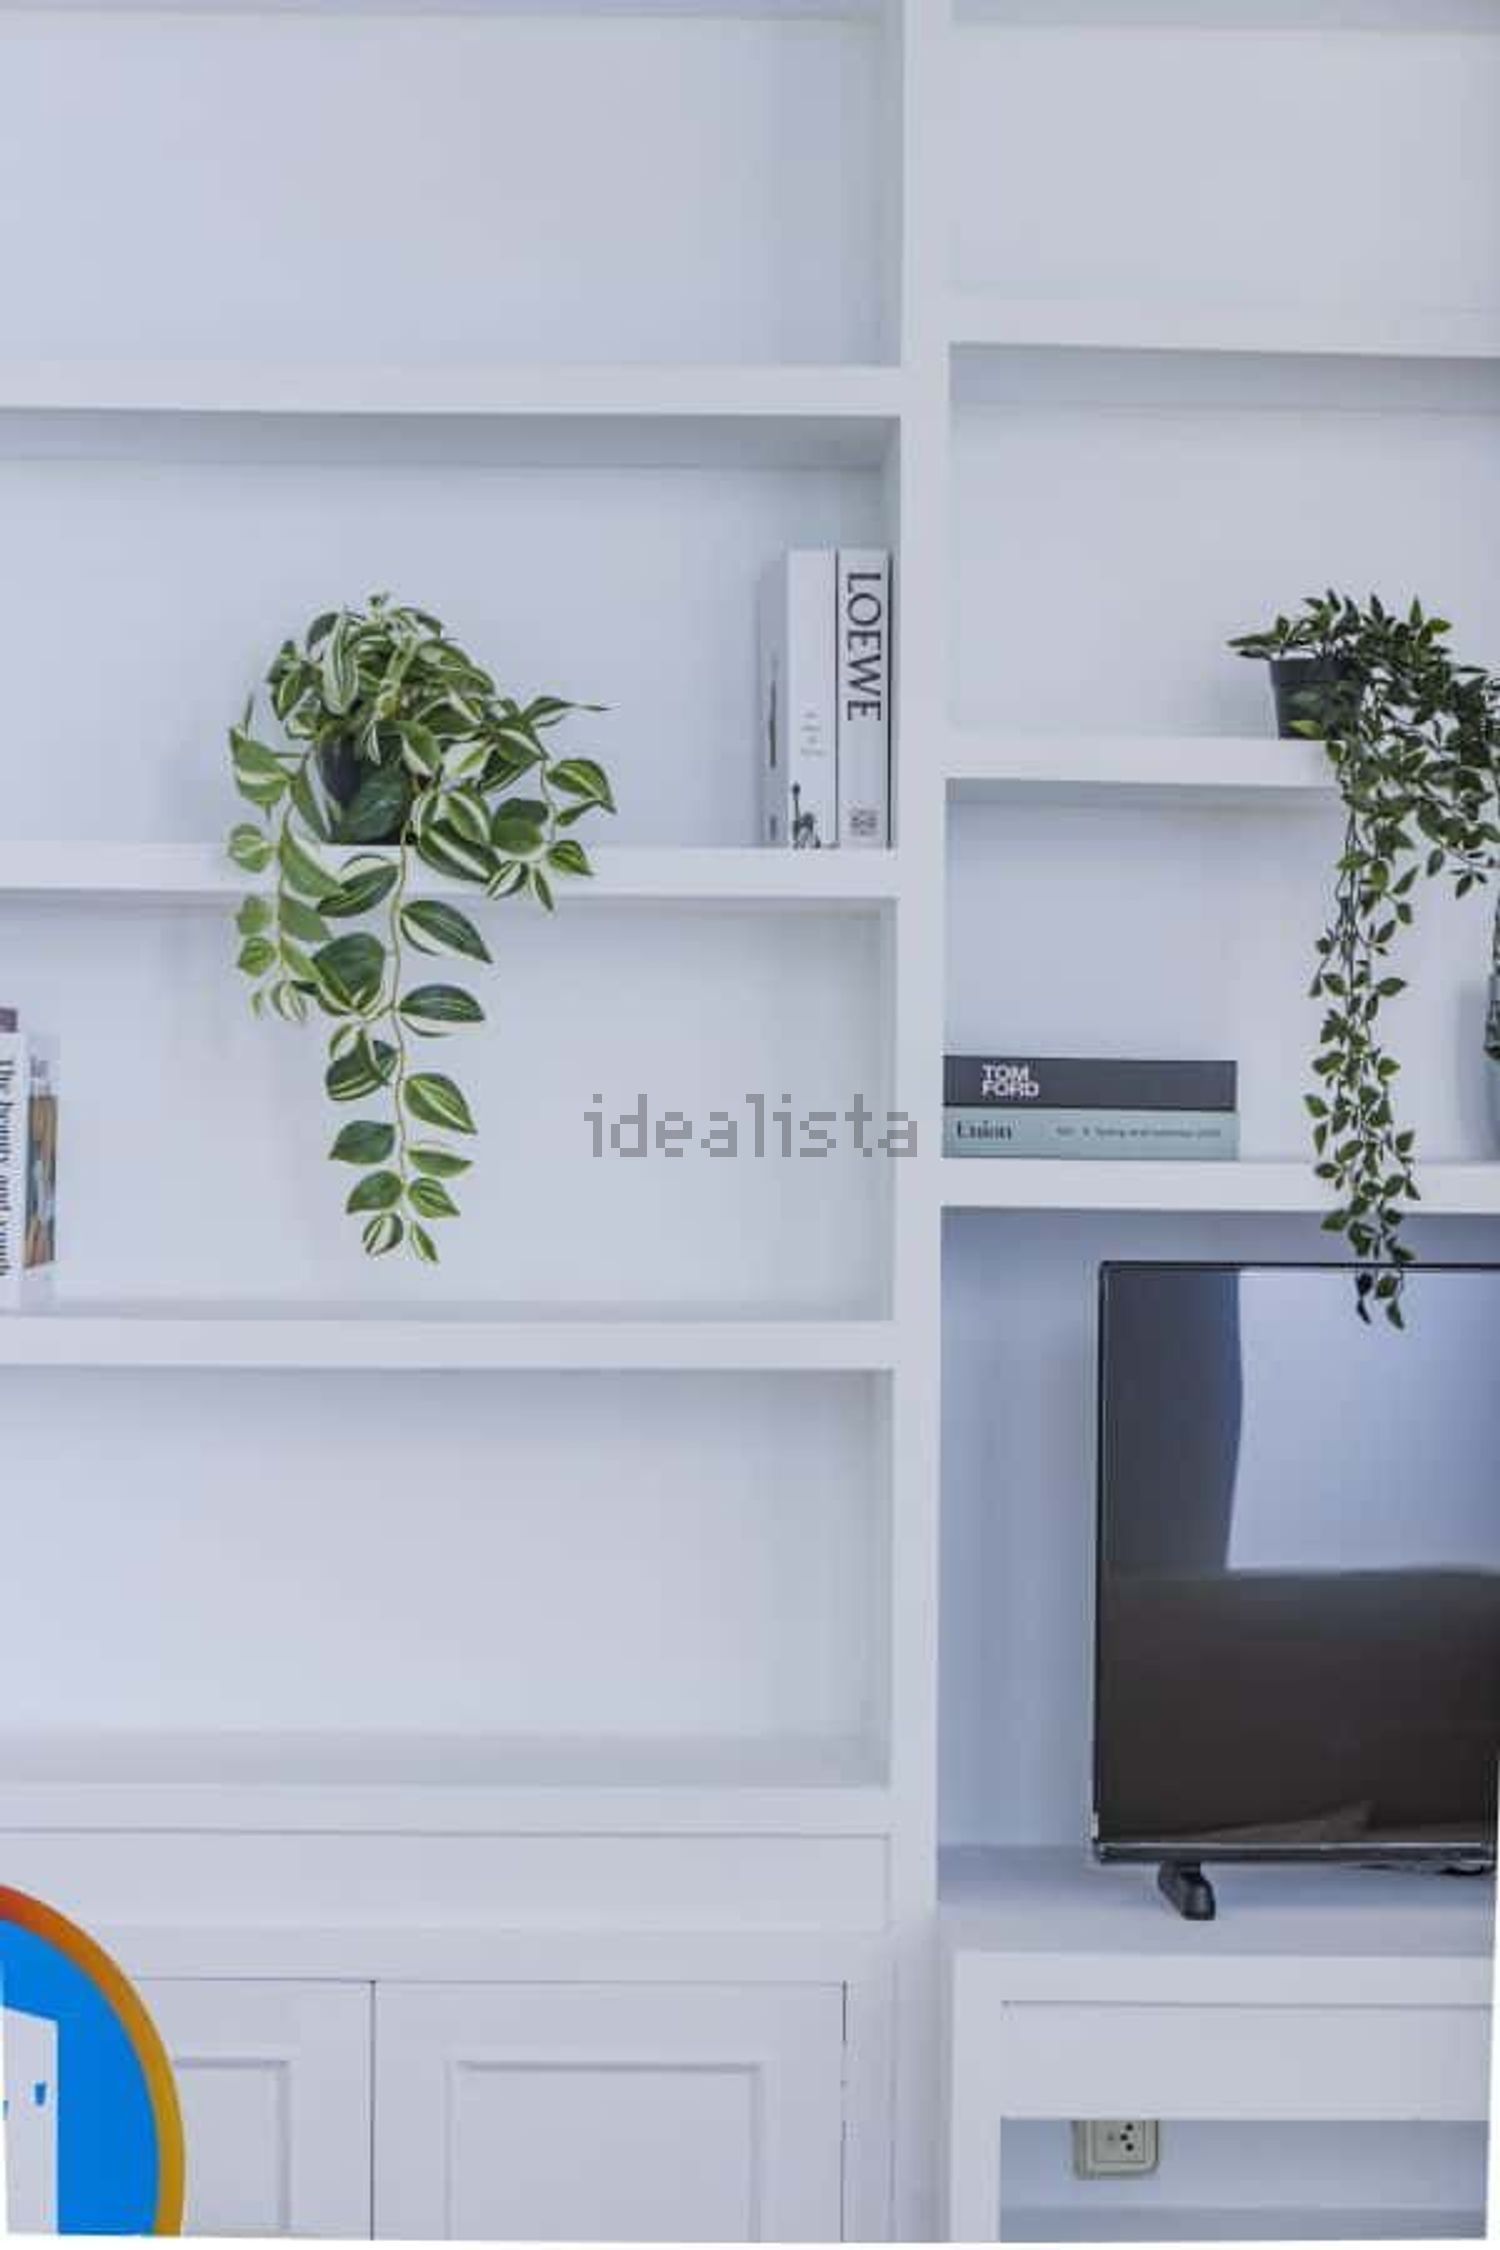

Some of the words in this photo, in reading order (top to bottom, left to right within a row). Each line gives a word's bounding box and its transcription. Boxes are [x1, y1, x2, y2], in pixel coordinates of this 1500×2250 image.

[847, 572, 882, 721] LOEWE
[981, 1064, 1030, 1081] TOM
[982, 1080, 1040, 1097] FORD
